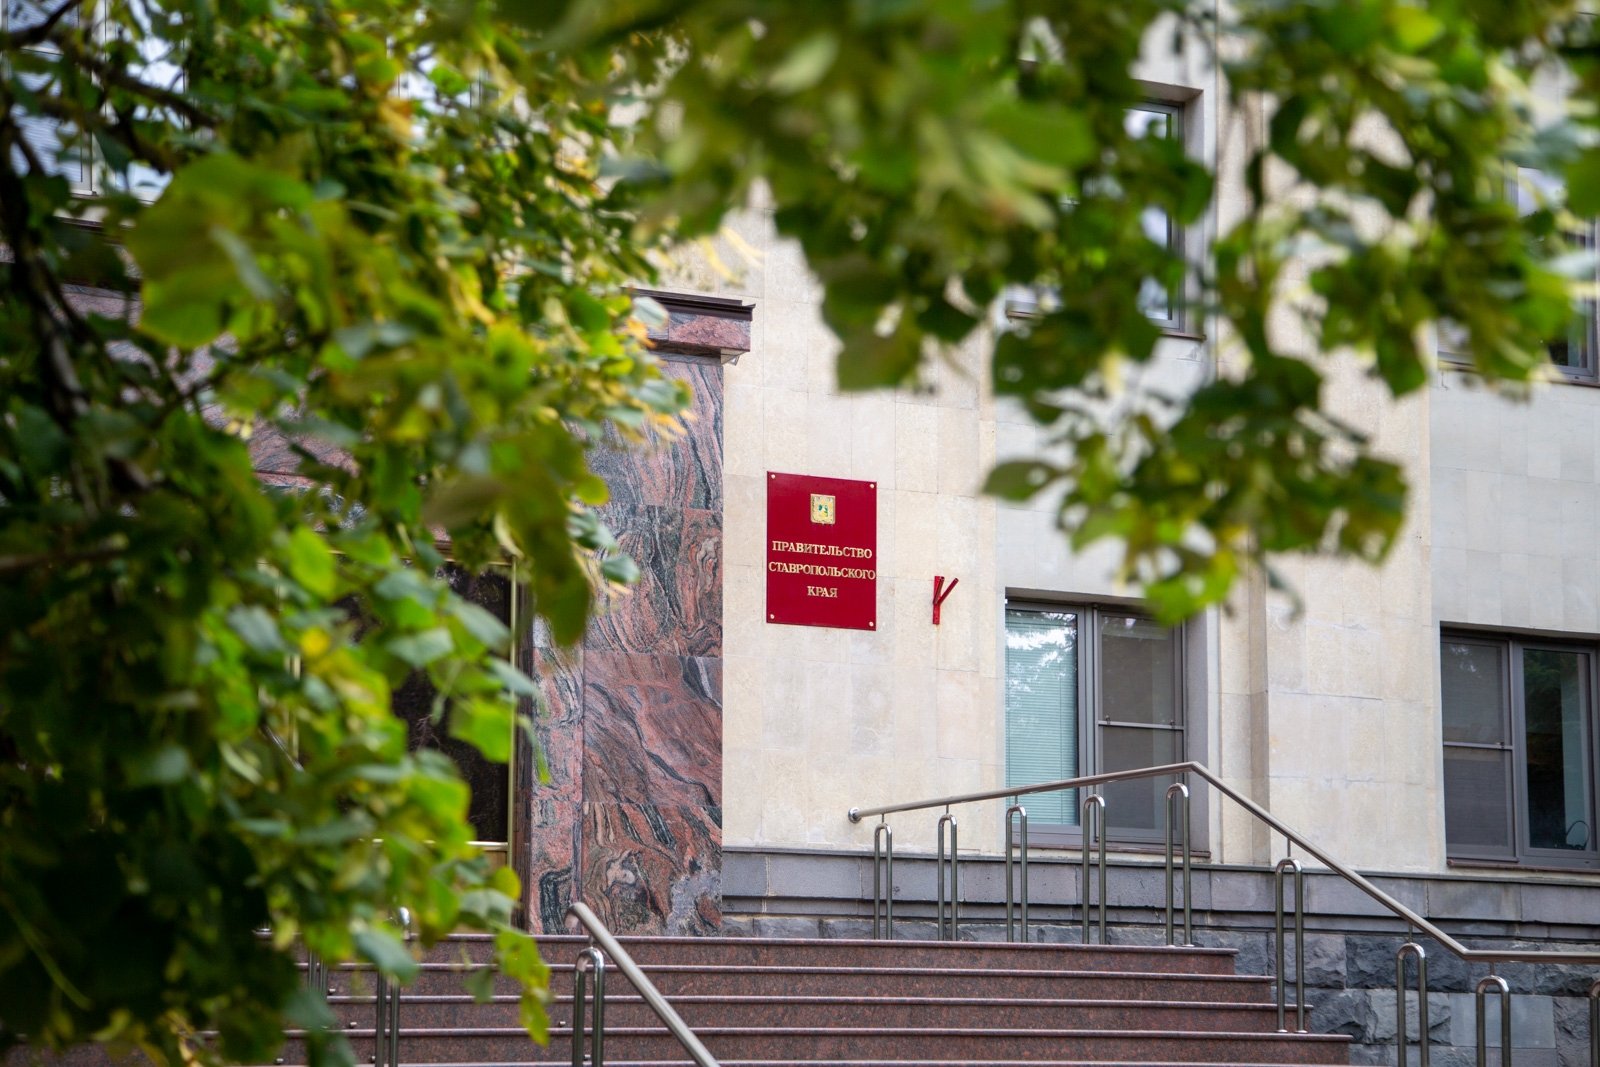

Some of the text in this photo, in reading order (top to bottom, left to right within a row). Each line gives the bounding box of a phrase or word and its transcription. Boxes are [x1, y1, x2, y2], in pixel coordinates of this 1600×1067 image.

[772, 540, 872, 559] ПРАВИТЕЛЬСТВО
[768, 561, 876, 580] СТАВРОПОЛЬСКОГО
[807, 586, 838, 598] КРАЯ
